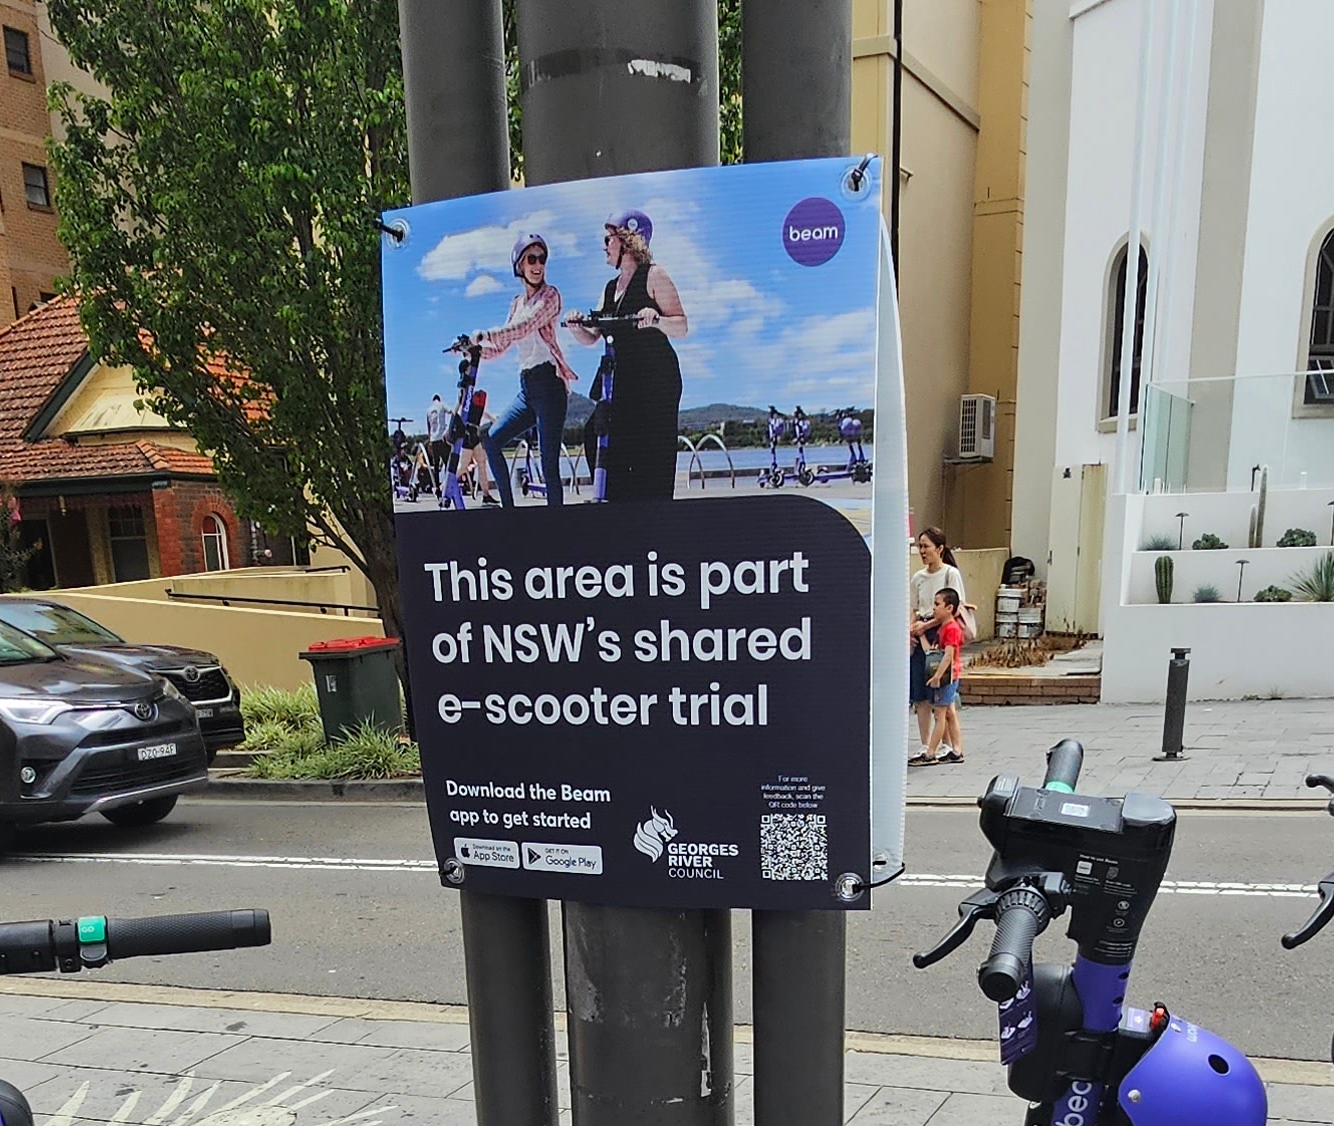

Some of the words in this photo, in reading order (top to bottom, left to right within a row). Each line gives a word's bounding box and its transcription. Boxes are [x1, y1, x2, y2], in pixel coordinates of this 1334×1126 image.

[789, 225, 838, 241] beam
[424, 557, 514, 602] This
[524, 563, 635, 600] area
[647, 551, 686, 597] is
[700, 551, 810, 610] part
[432, 622, 473, 664] of
[483, 616, 622, 664] NSW's
[634, 616, 812, 662] shared
[438, 687, 658, 726] e-scooter
[669, 682, 768, 726] trial
[446, 780, 525, 799] Download
[529, 783, 557, 801] the
[561, 784, 611, 803] Beam
[450, 810, 479, 826] app
[483, 809, 499, 824] to
[503, 811, 528, 829] get
[533, 812, 591, 830] started
[473, 850, 490, 862] App
[491, 851, 515, 863] Store
[667, 843, 740, 857] GEORGES
[546, 855, 577, 868] Google
[578, 857, 597, 870] Play
[668, 855, 713, 868] RIVER
[668, 867, 724, 880] COUNCIL
